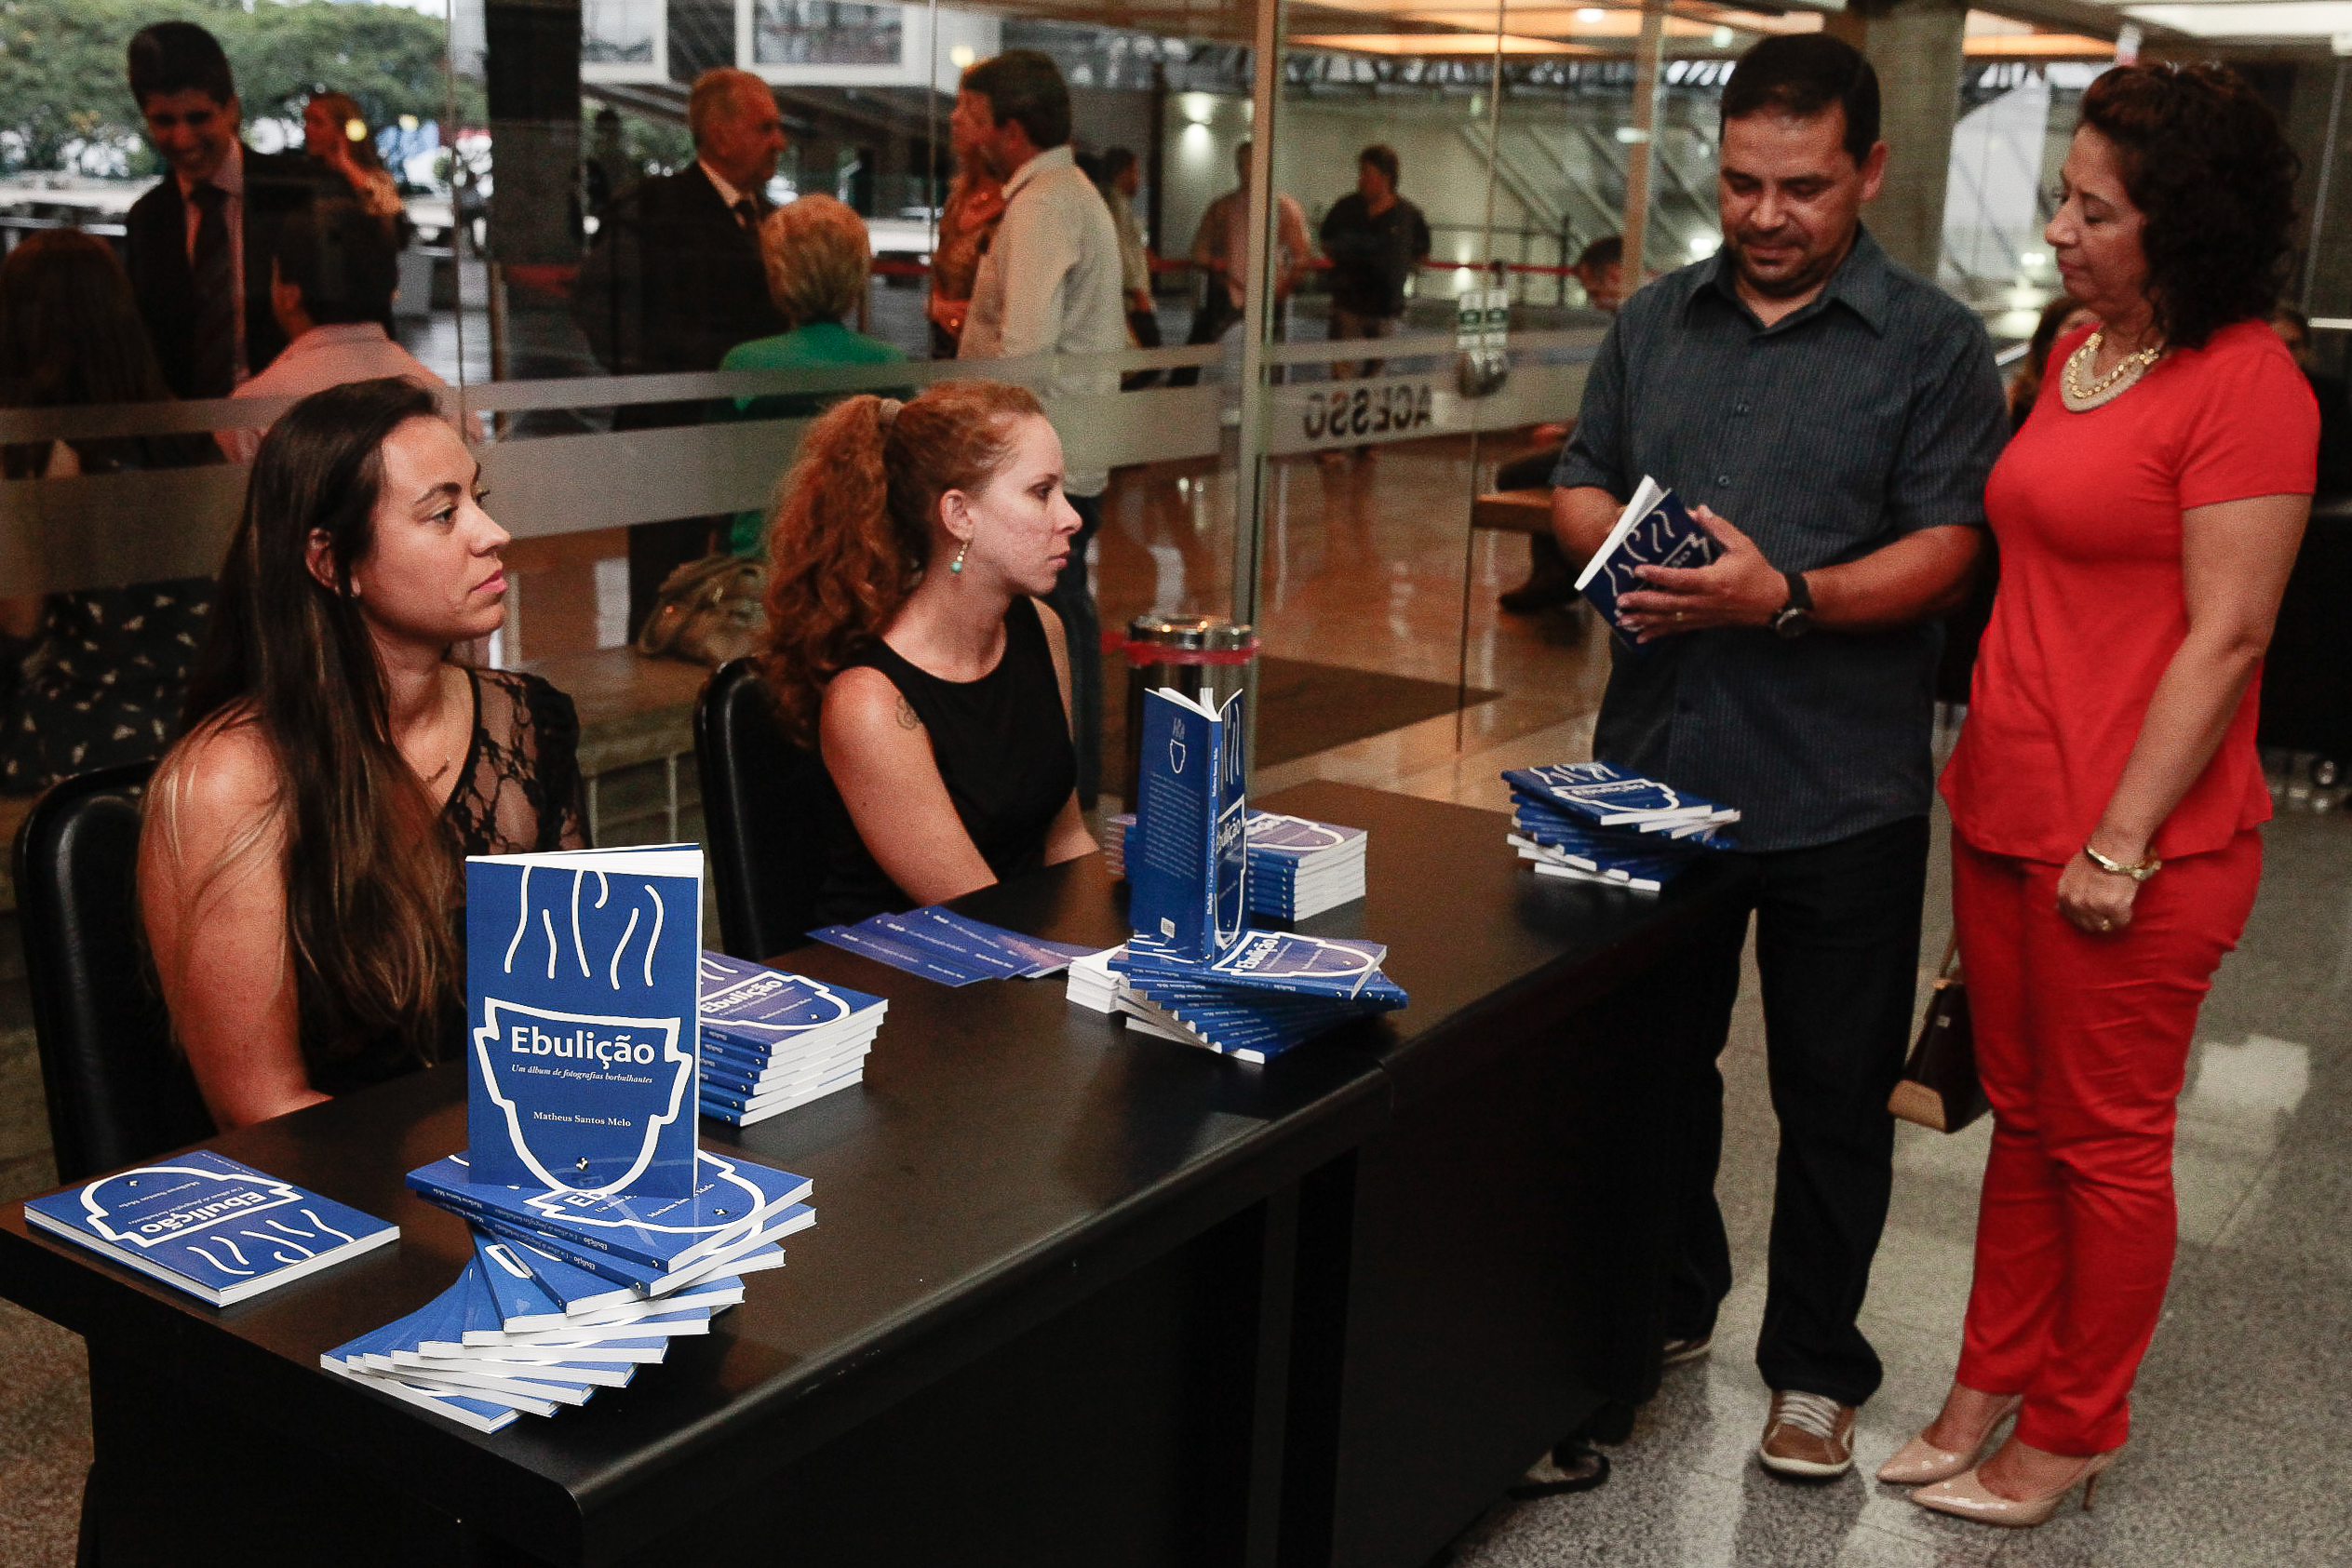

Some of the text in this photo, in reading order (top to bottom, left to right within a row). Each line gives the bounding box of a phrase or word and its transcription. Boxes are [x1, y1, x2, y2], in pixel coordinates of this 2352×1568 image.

[701, 980, 784, 1013] Ebulição
[511, 1025, 655, 1070] Ebulição
[512, 1064, 653, 1084] Um álbum de fotografias borbulhantes
[533, 1111, 631, 1127] Matheus Santos Melo
[140, 1191, 267, 1233] Ebulição
